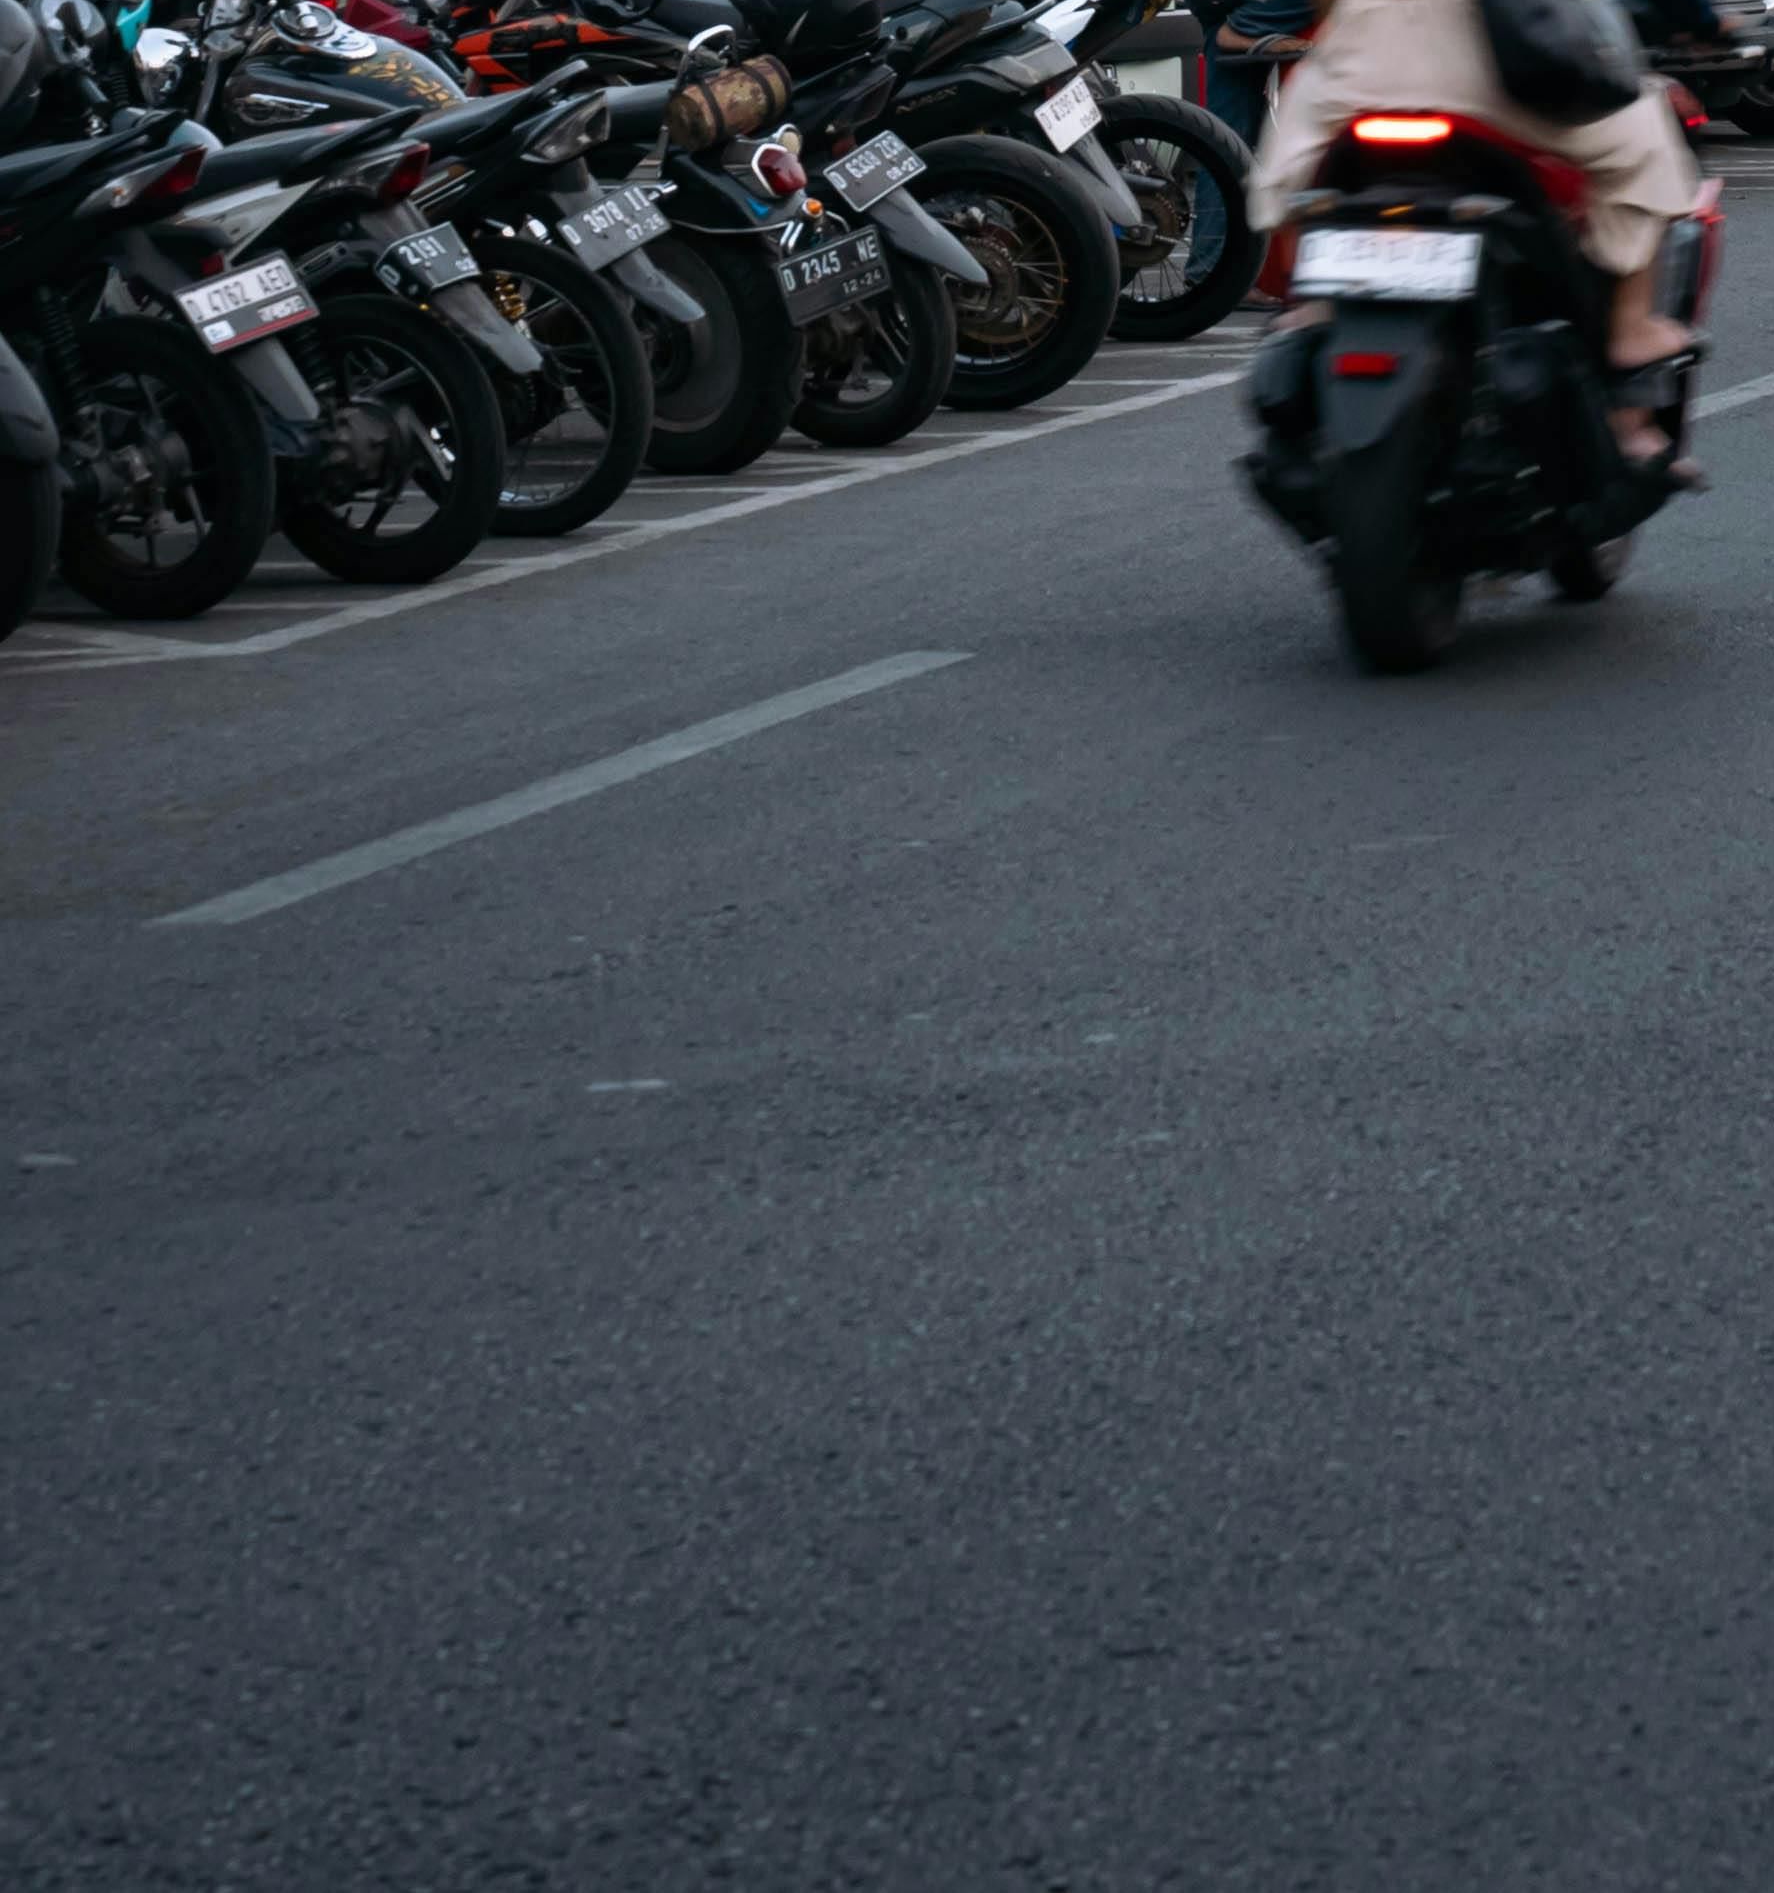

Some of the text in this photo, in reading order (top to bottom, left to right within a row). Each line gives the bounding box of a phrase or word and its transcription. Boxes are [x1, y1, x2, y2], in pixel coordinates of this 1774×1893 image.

[828, 171, 848, 190] D
[561, 223, 582, 246] D
[380, 235, 448, 286] D 2191
[782, 268, 796, 292] D
[801, 249, 842, 285] 2345
[206, 280, 252, 313] 4762
